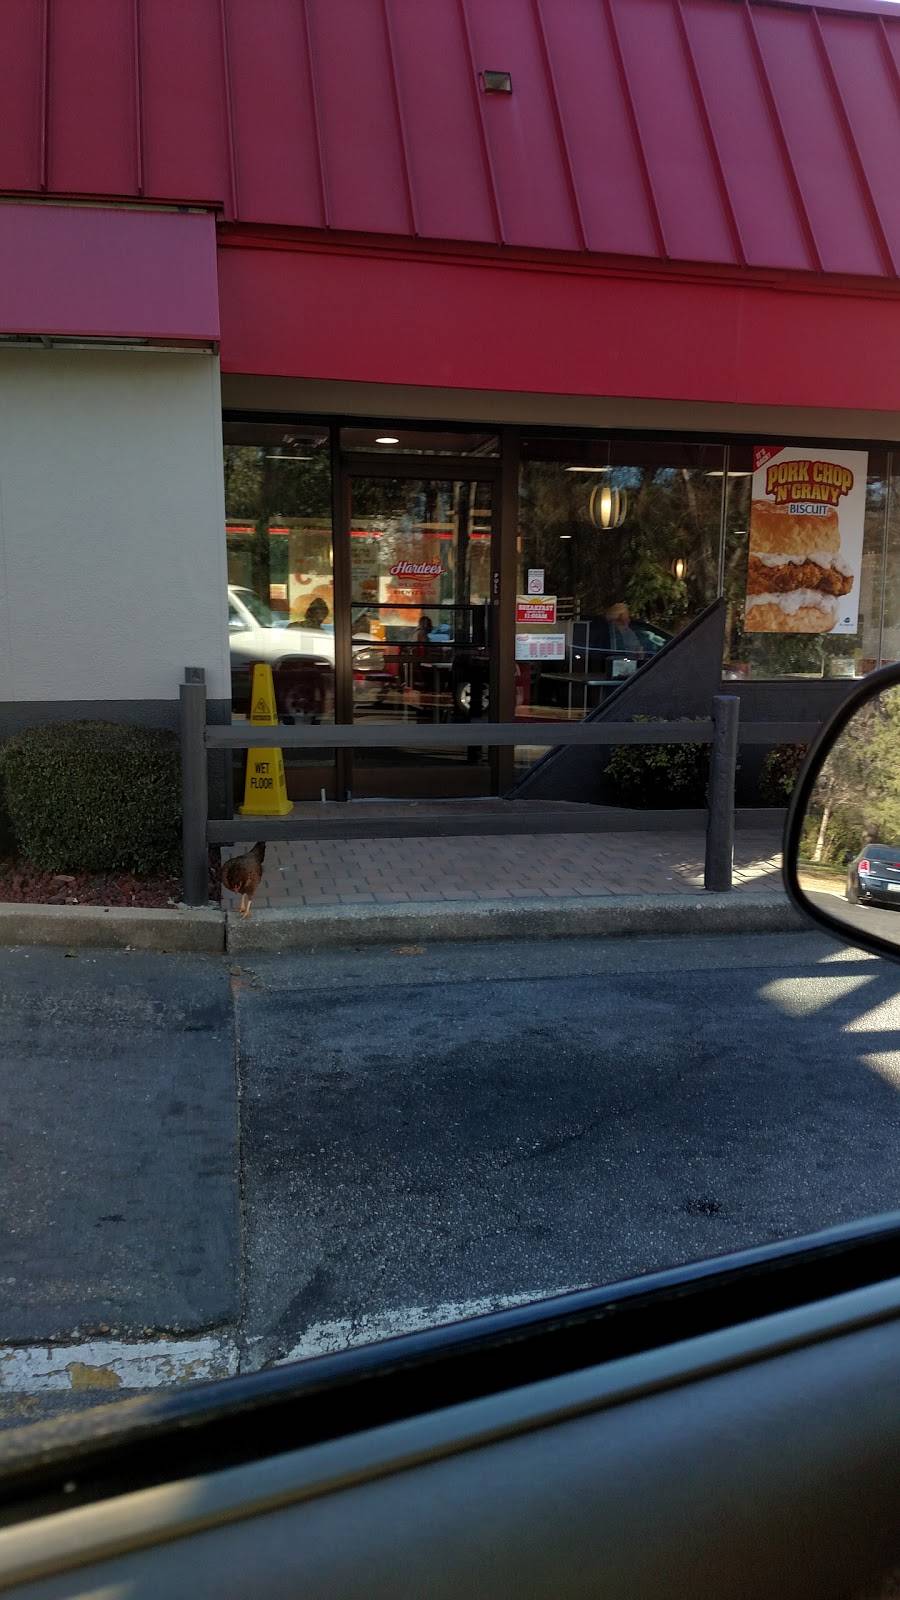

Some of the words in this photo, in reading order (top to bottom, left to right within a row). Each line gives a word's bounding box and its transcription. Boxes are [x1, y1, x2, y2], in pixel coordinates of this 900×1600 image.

[767, 460, 809, 492] PORK
[812, 461, 852, 492] CHOP
[791, 484, 839, 503] GRAVY
[790, 504, 827, 514] BISCUIT
[255, 763, 270, 774] WET
[251, 777, 273, 789] FLOOR
